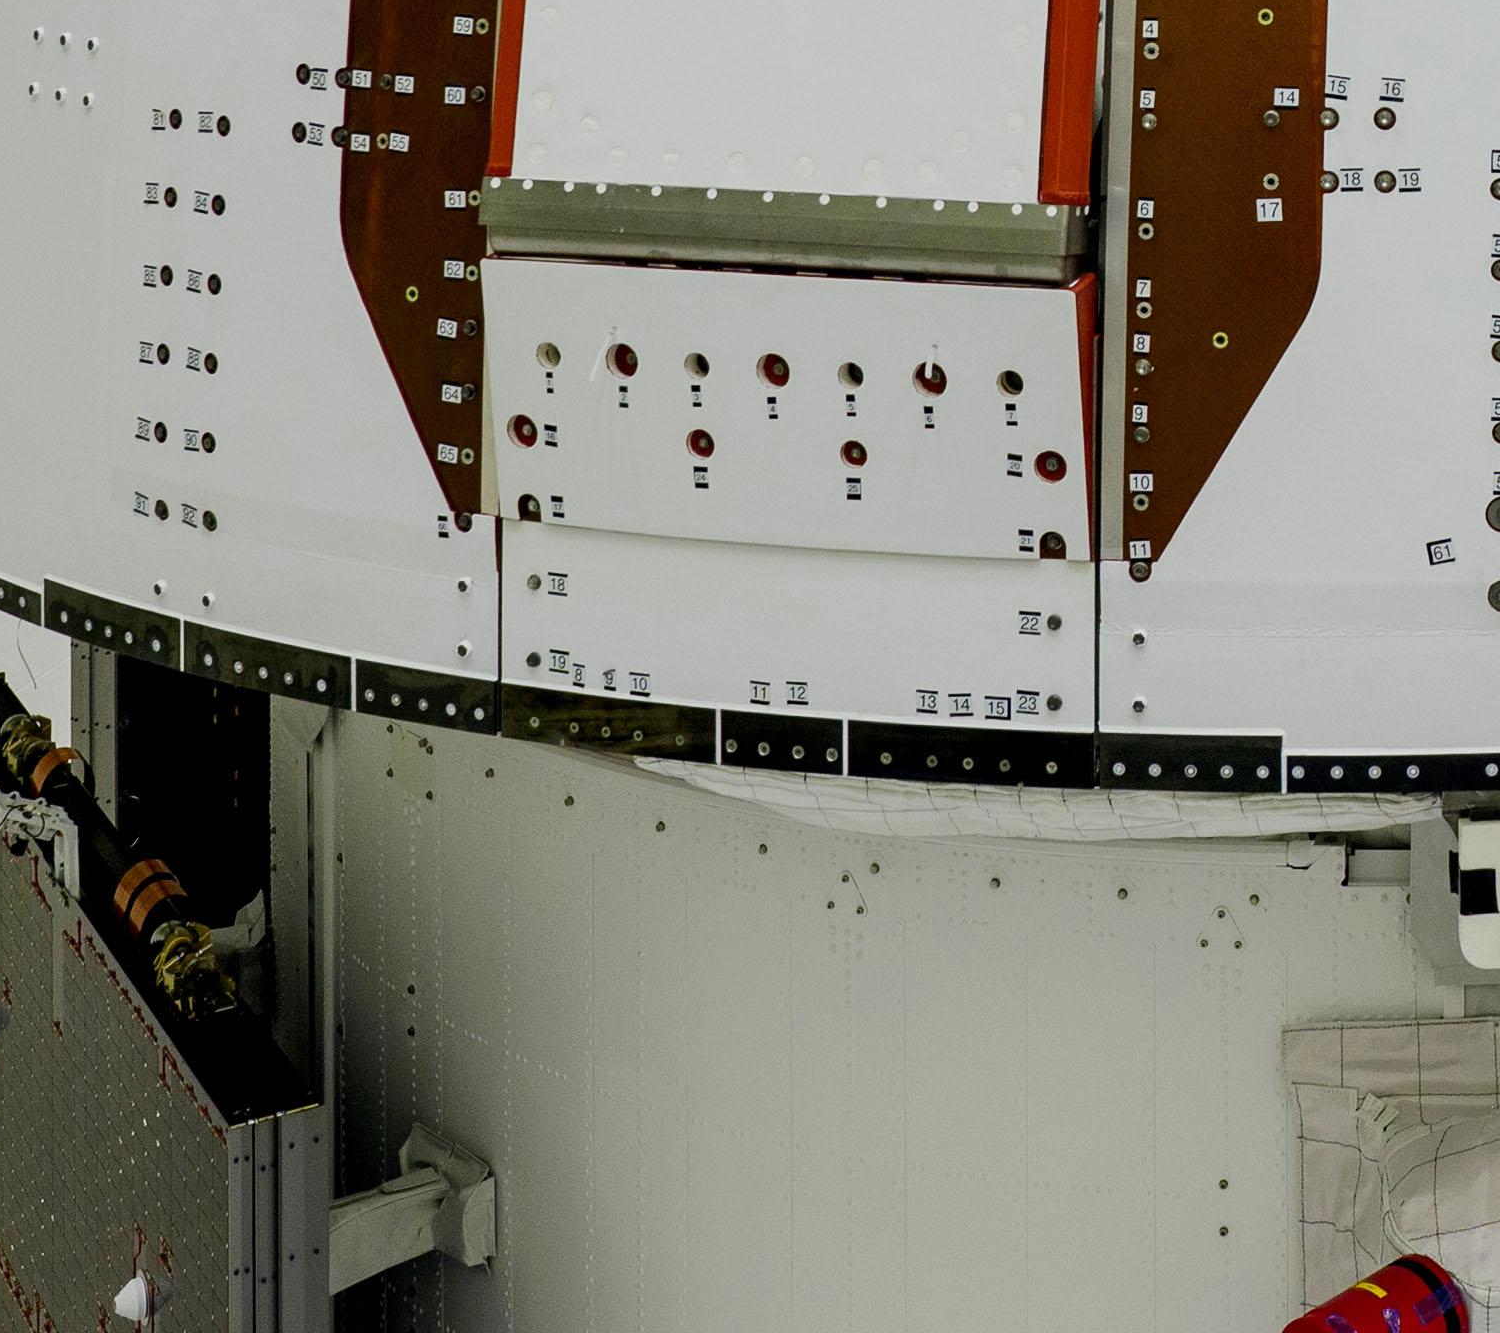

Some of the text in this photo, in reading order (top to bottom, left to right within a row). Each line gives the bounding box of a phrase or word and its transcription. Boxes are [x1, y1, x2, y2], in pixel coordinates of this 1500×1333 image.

[456, 19, 471, 33] 59
[1145, 23, 1154, 35] 4
[312, 73, 326, 86] 50
[355, 72, 367, 85] 51
[397, 78, 411, 91] 52
[1331, 79, 1346, 94] 15
[1384, 82, 1401, 96] 16
[447, 89, 462, 103] 60
[1142, 93, 1151, 106] 5
[1279, 91, 1295, 104] 14
[309, 127, 322, 141] 53
[353, 137, 366, 148] 54
[392, 135, 405, 149] 55
[1344, 172, 1361, 186] 18
[1402, 172, 1419, 187] 19
[448, 192, 462, 206] 61
[1140, 202, 1149, 216] 6
[1260, 202, 1280, 218] 17
[446, 262, 461, 276] 62
[1140, 281, 1148, 295] 7
[440, 321, 454, 335] 63
[1136, 336, 1145, 351] 8
[444, 389, 458, 400] 64
[1134, 407, 1143, 421] 9
[440, 446, 454, 461] 65
[1133, 475, 1150, 490] 10
[1132, 543, 1146, 556] 11
[1433, 544, 1450, 560] 61
[551, 578, 565, 592] 18
[1020, 616, 1039, 631] 22
[552, 655, 566, 669] 19
[574, 668, 582, 682] 8
[605, 672, 613, 685] 9
[632, 677, 648, 691] 10
[753, 685, 766, 699] 11
[790, 686, 806, 700] 12
[920, 695, 936, 709] 13
[953, 698, 970, 711] 14
[988, 701, 1005, 715] 15
[1018, 695, 1037, 711] 23
